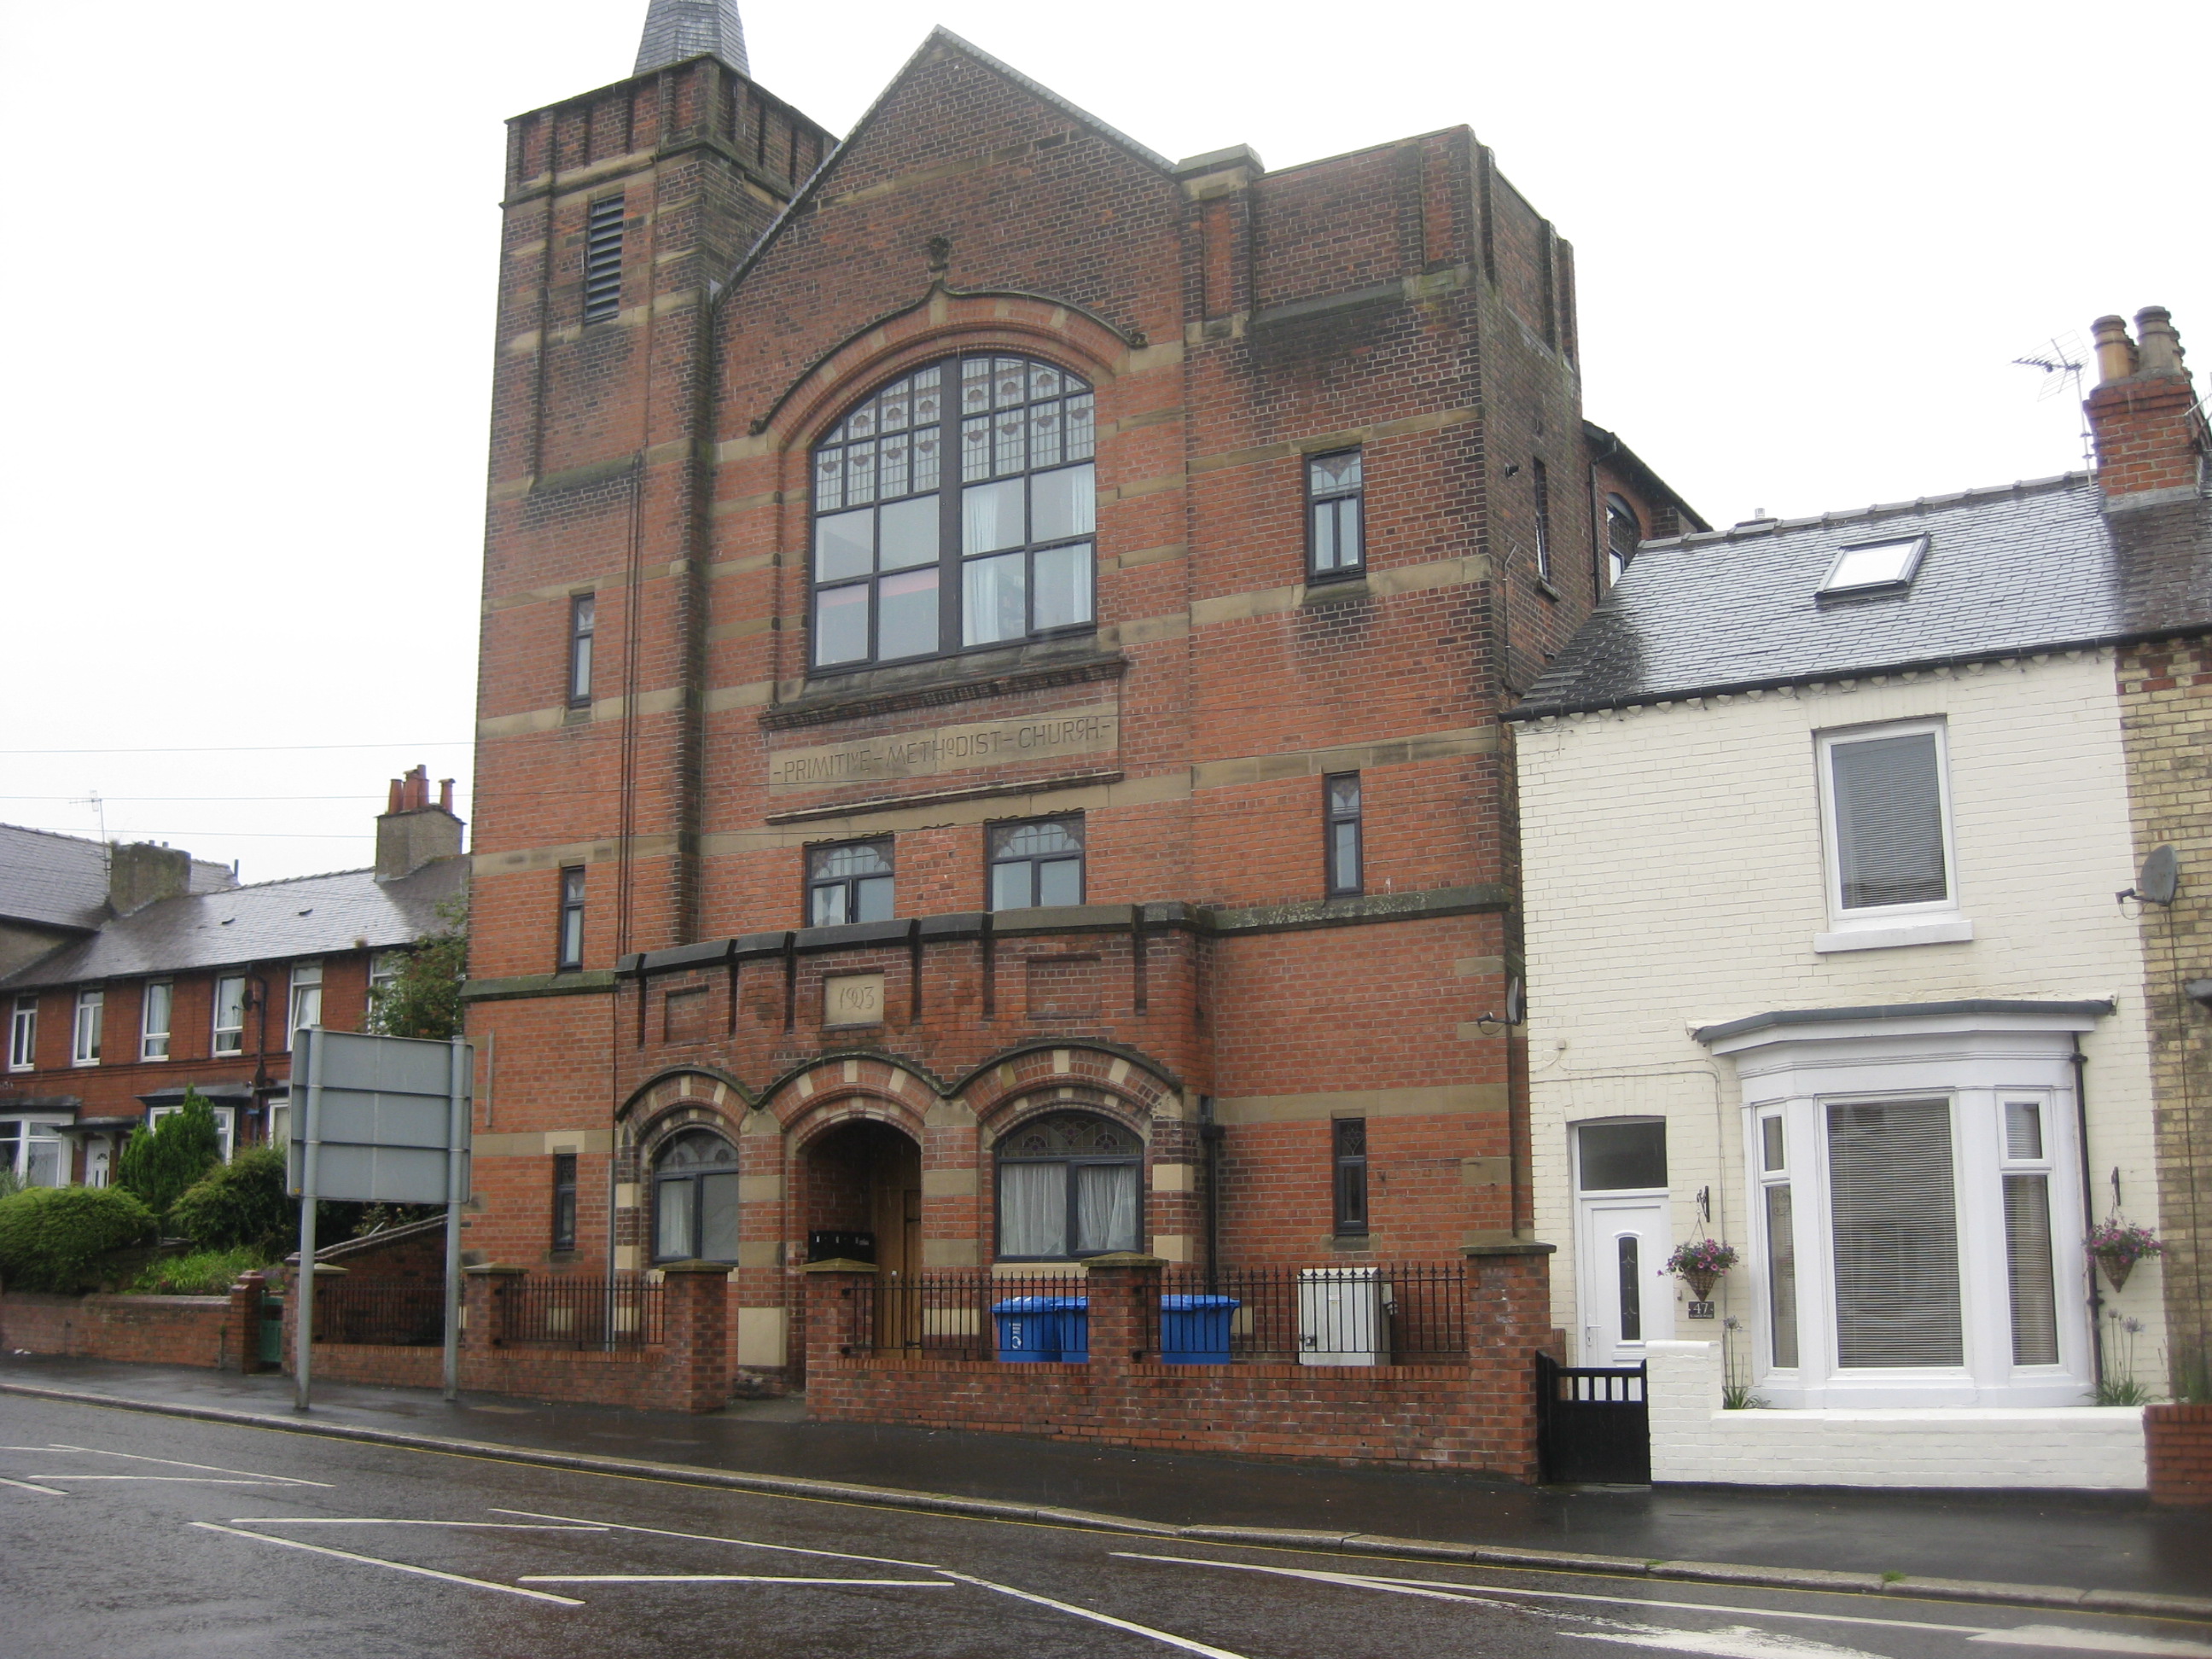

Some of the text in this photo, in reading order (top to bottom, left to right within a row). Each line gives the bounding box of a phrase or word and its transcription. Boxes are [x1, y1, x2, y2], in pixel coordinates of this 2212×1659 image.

[784, 749, 871, 783] PRIMITIVE
[885, 731, 1002, 767] METHODIST
[839, 986, 875, 1010] 1903
[1693, 1302, 1708, 1314] 47
